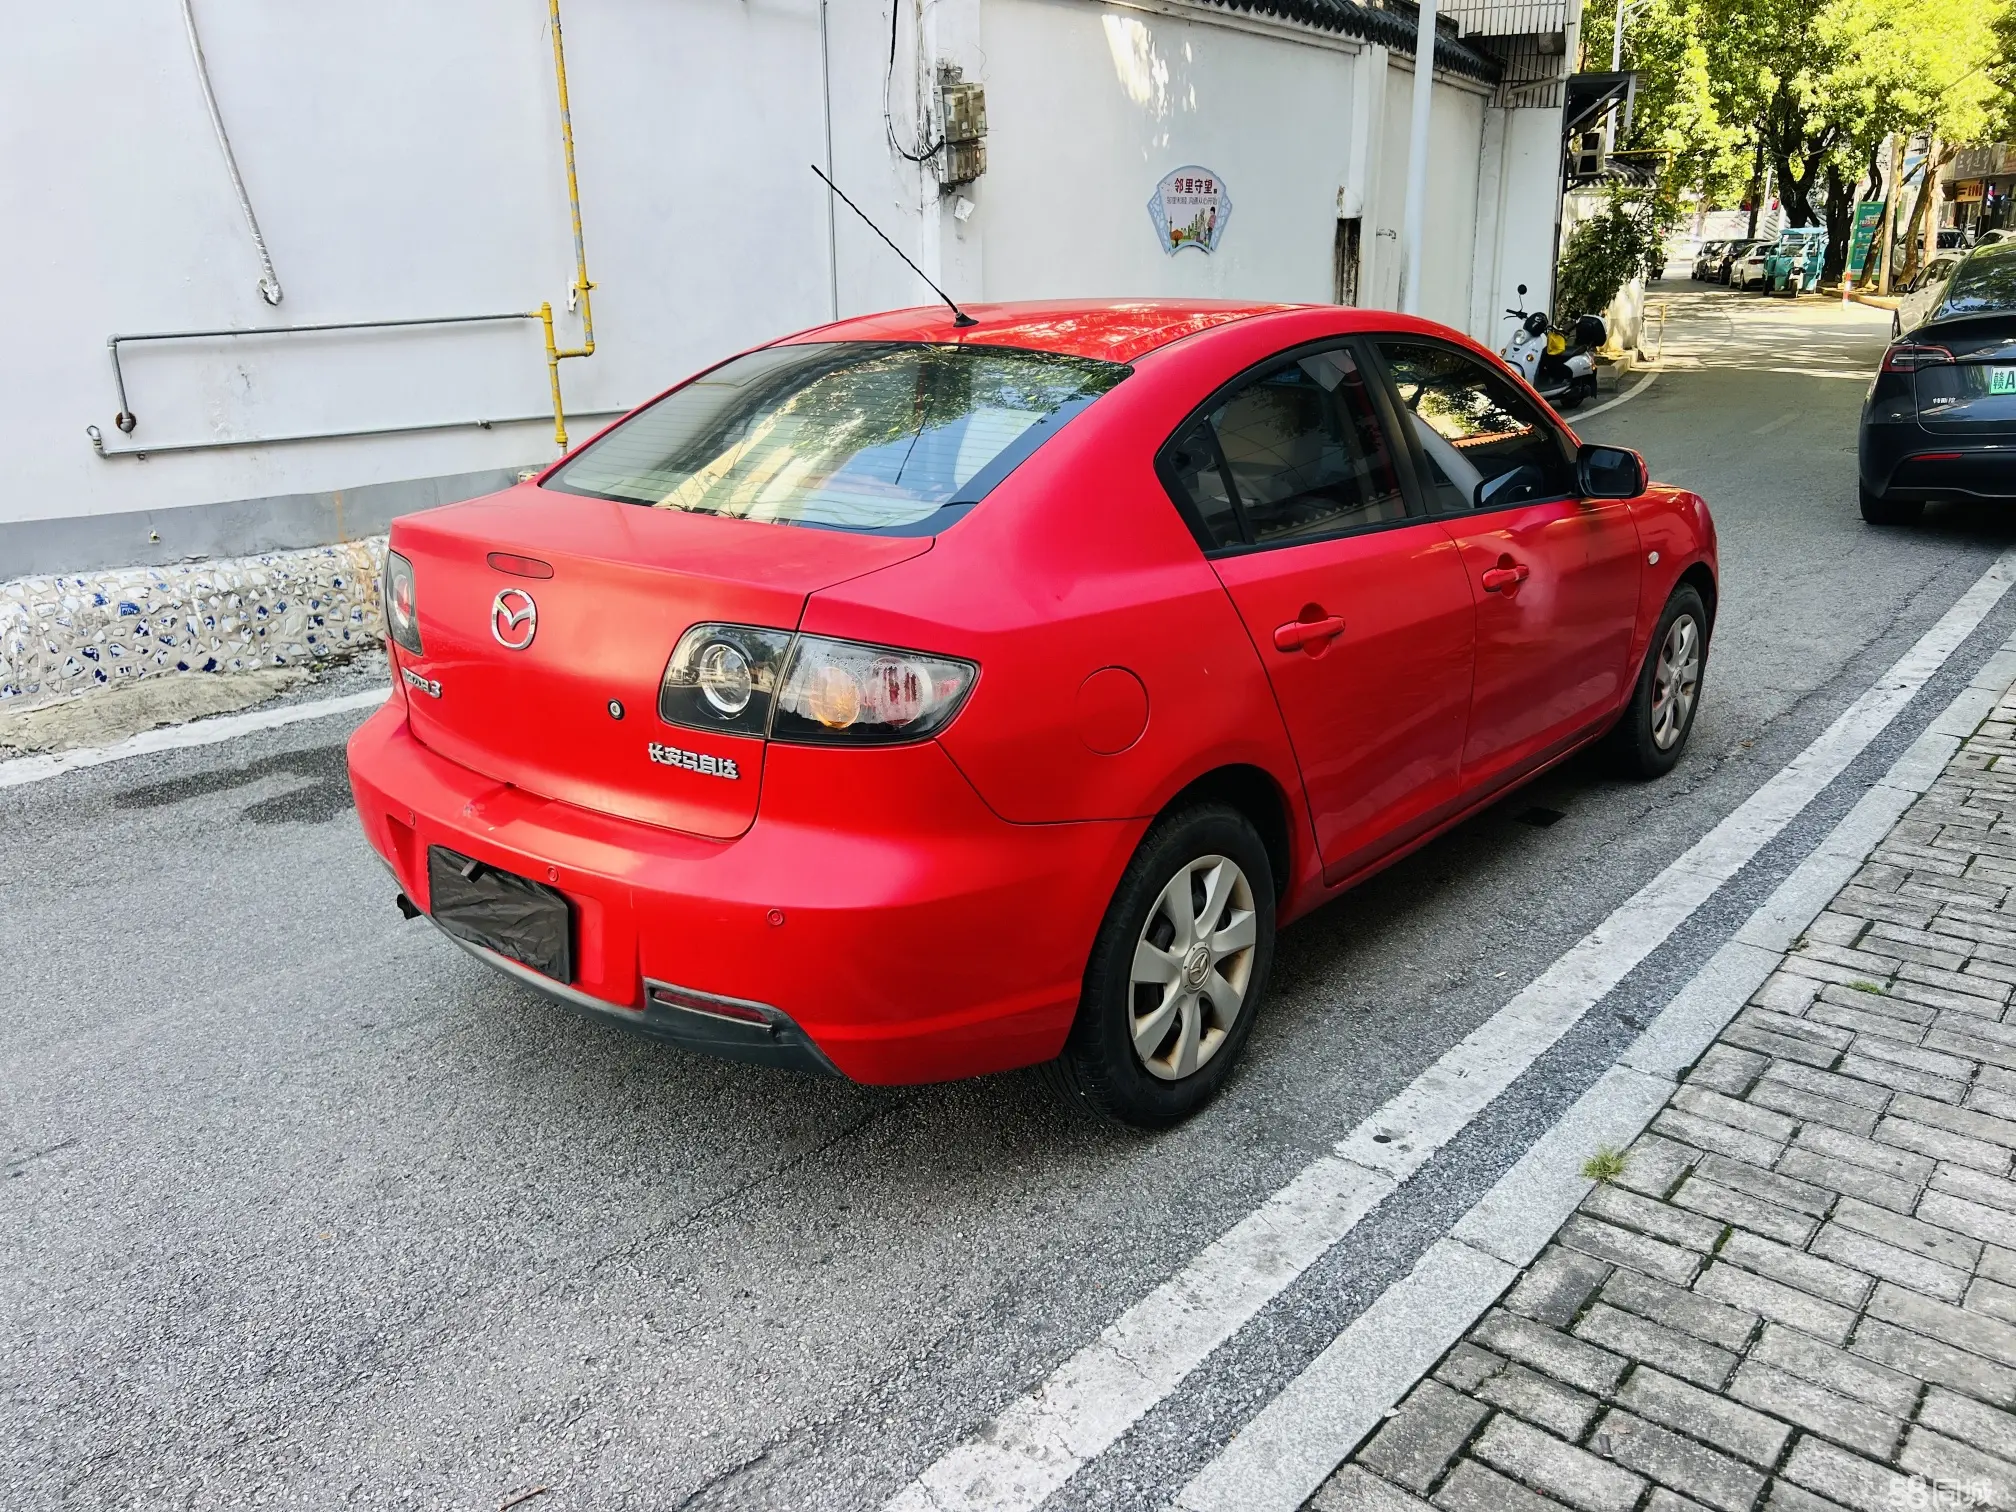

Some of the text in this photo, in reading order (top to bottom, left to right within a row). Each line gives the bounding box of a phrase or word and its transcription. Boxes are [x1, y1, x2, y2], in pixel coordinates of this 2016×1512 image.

[1174, 177, 1213, 194] 邻里守望
[648, 742, 740, 780] 长安马自达
